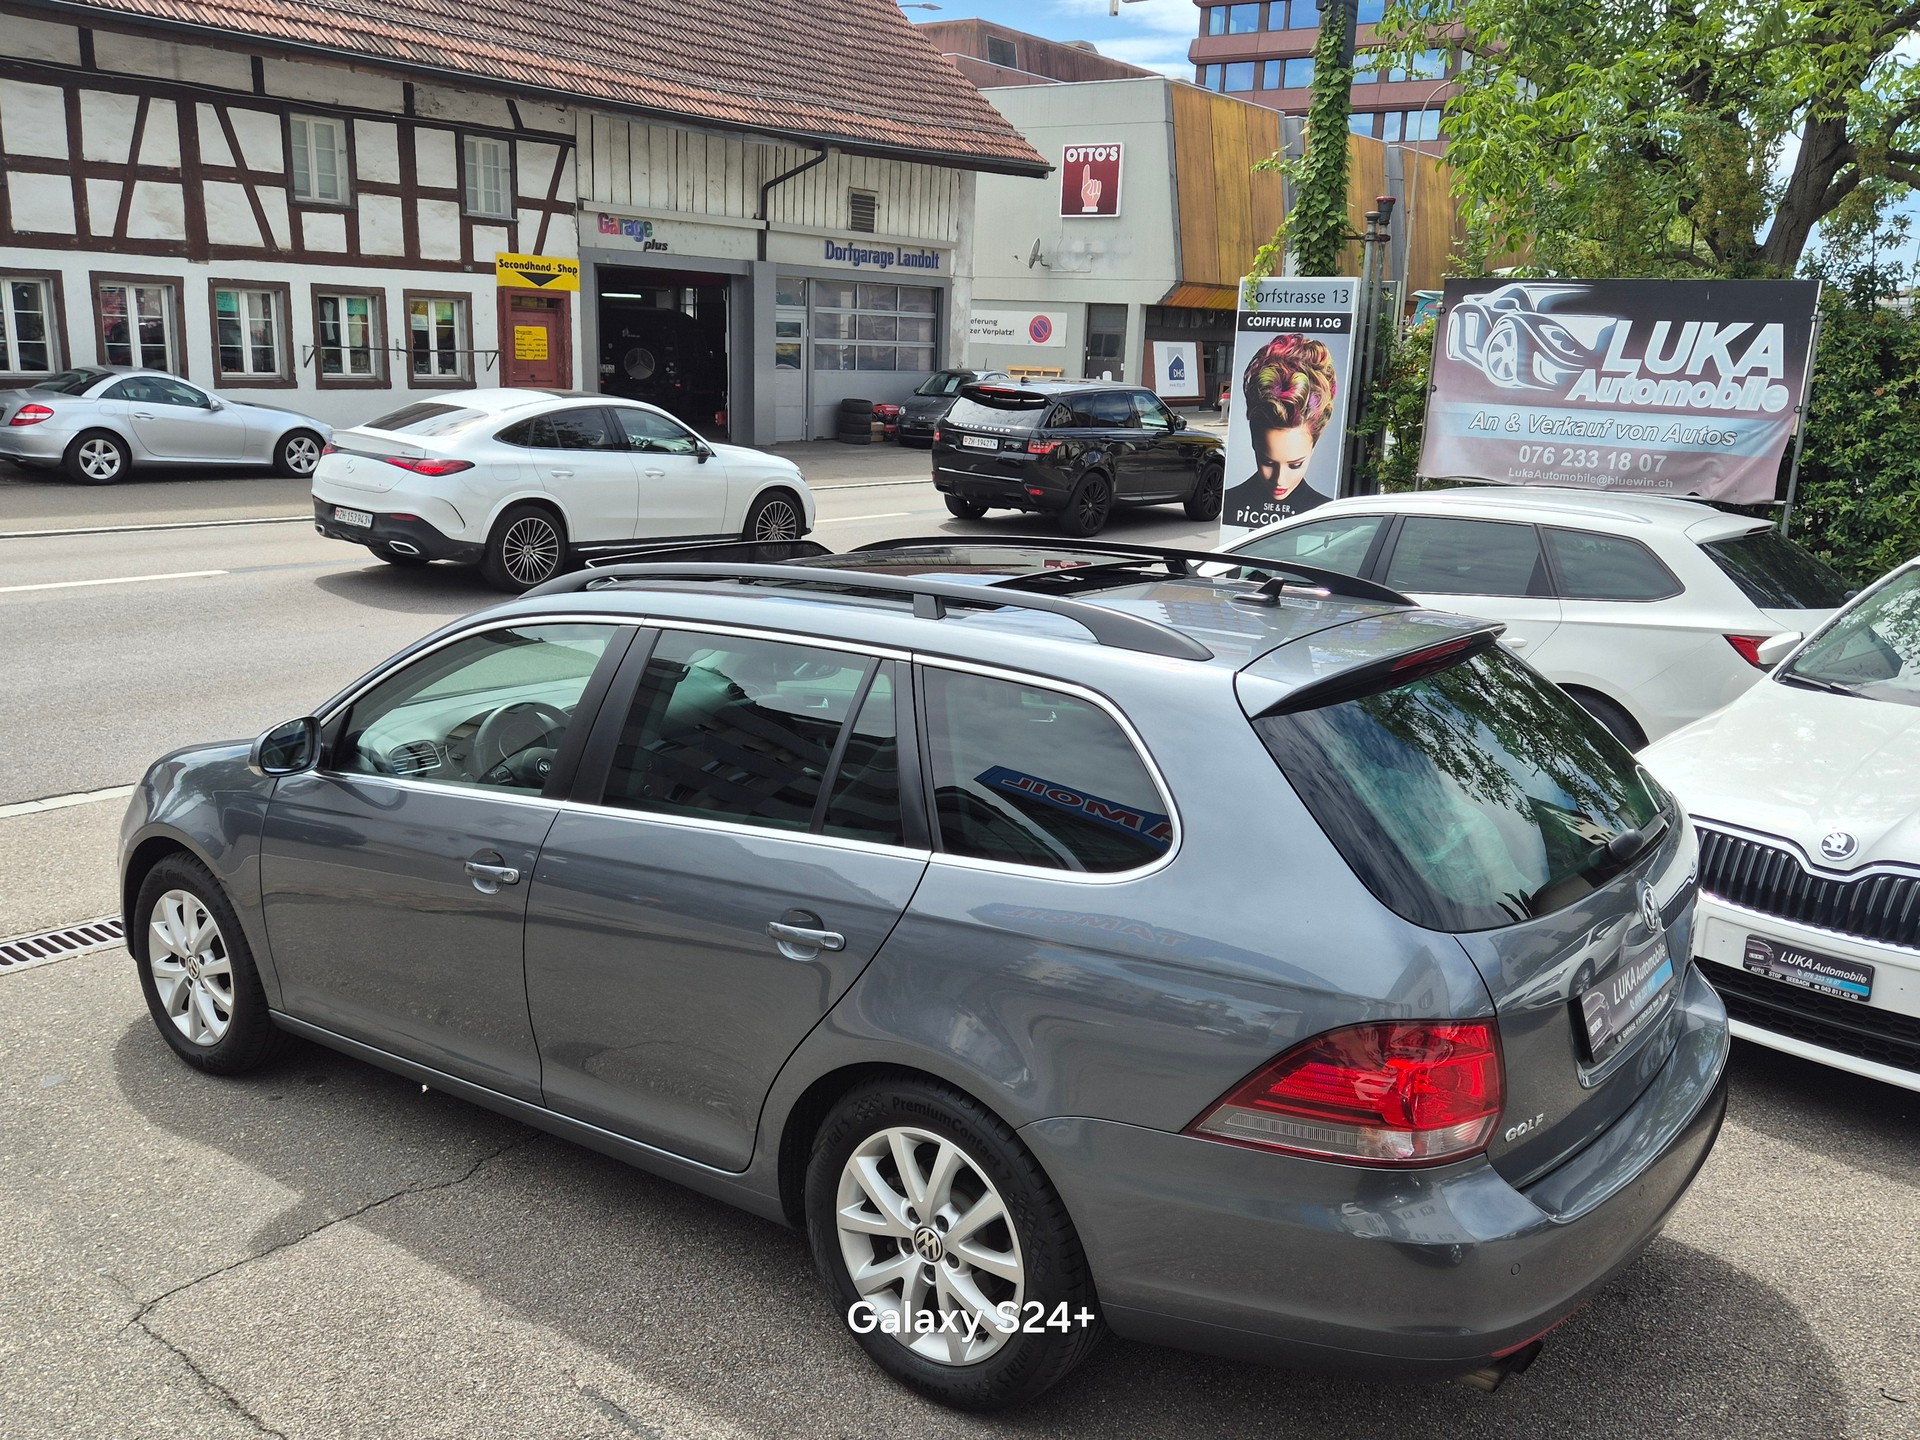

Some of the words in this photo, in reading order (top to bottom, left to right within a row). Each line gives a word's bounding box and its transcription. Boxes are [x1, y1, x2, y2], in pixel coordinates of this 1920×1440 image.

[1066, 146, 1119, 163] OTTO'S
[597, 212, 653, 243] Garage
[643, 239, 669, 252] plus
[824, 240, 895, 269] Dorfgarage
[897, 247, 940, 270] Landolt
[498, 259, 552, 272] Secondhand
[557, 263, 578, 275] Shop
[1244, 288, 1326, 304] orfstrasse
[1332, 289, 1349, 304] 13
[982, 328, 1015, 336] Vorplatz!
[1247, 316, 1296, 328] COIFFURE
[1298, 317, 1312, 328] IM
[1316, 317, 1342, 329] 1.OG
[1600, 319, 1784, 379] LUKA
[1173, 368, 1185, 378] DHG
[1564, 368, 1790, 413] Automobile
[981, 425, 1012, 433] ROVER
[1468, 411, 1500, 431] An
[1504, 412, 1521, 433] &
[1528, 414, 1614, 438] Verkauf
[1616, 423, 1660, 442] von
[1662, 423, 1739, 447] Autos
[1518, 445, 1556, 465] 076
[1560, 448, 1599, 470] 233
[1606, 451, 1632, 472] 18
[1638, 454, 1668, 474] 07
[1508, 467, 1674, 489] LukaAutomobile@bluewin.ch
[1263, 502, 1275, 511] SIE
[1275, 503, 1281, 512] &
[1282, 504, 1291, 513] ER
[1613, 966, 1637, 1006] LUKA
[1636, 942, 1666, 985] Automobile
[1750, 966, 1765, 975] AUTO
[1768, 971, 1783, 979] STOP
[1785, 975, 1810, 987] SEEBACH
[1780, 951, 1814, 970] LUKA
[1813, 964, 1868, 984] Automobile
[1803, 971, 1814, 979] 076
[1505, 1113, 1544, 1143] GOLF
